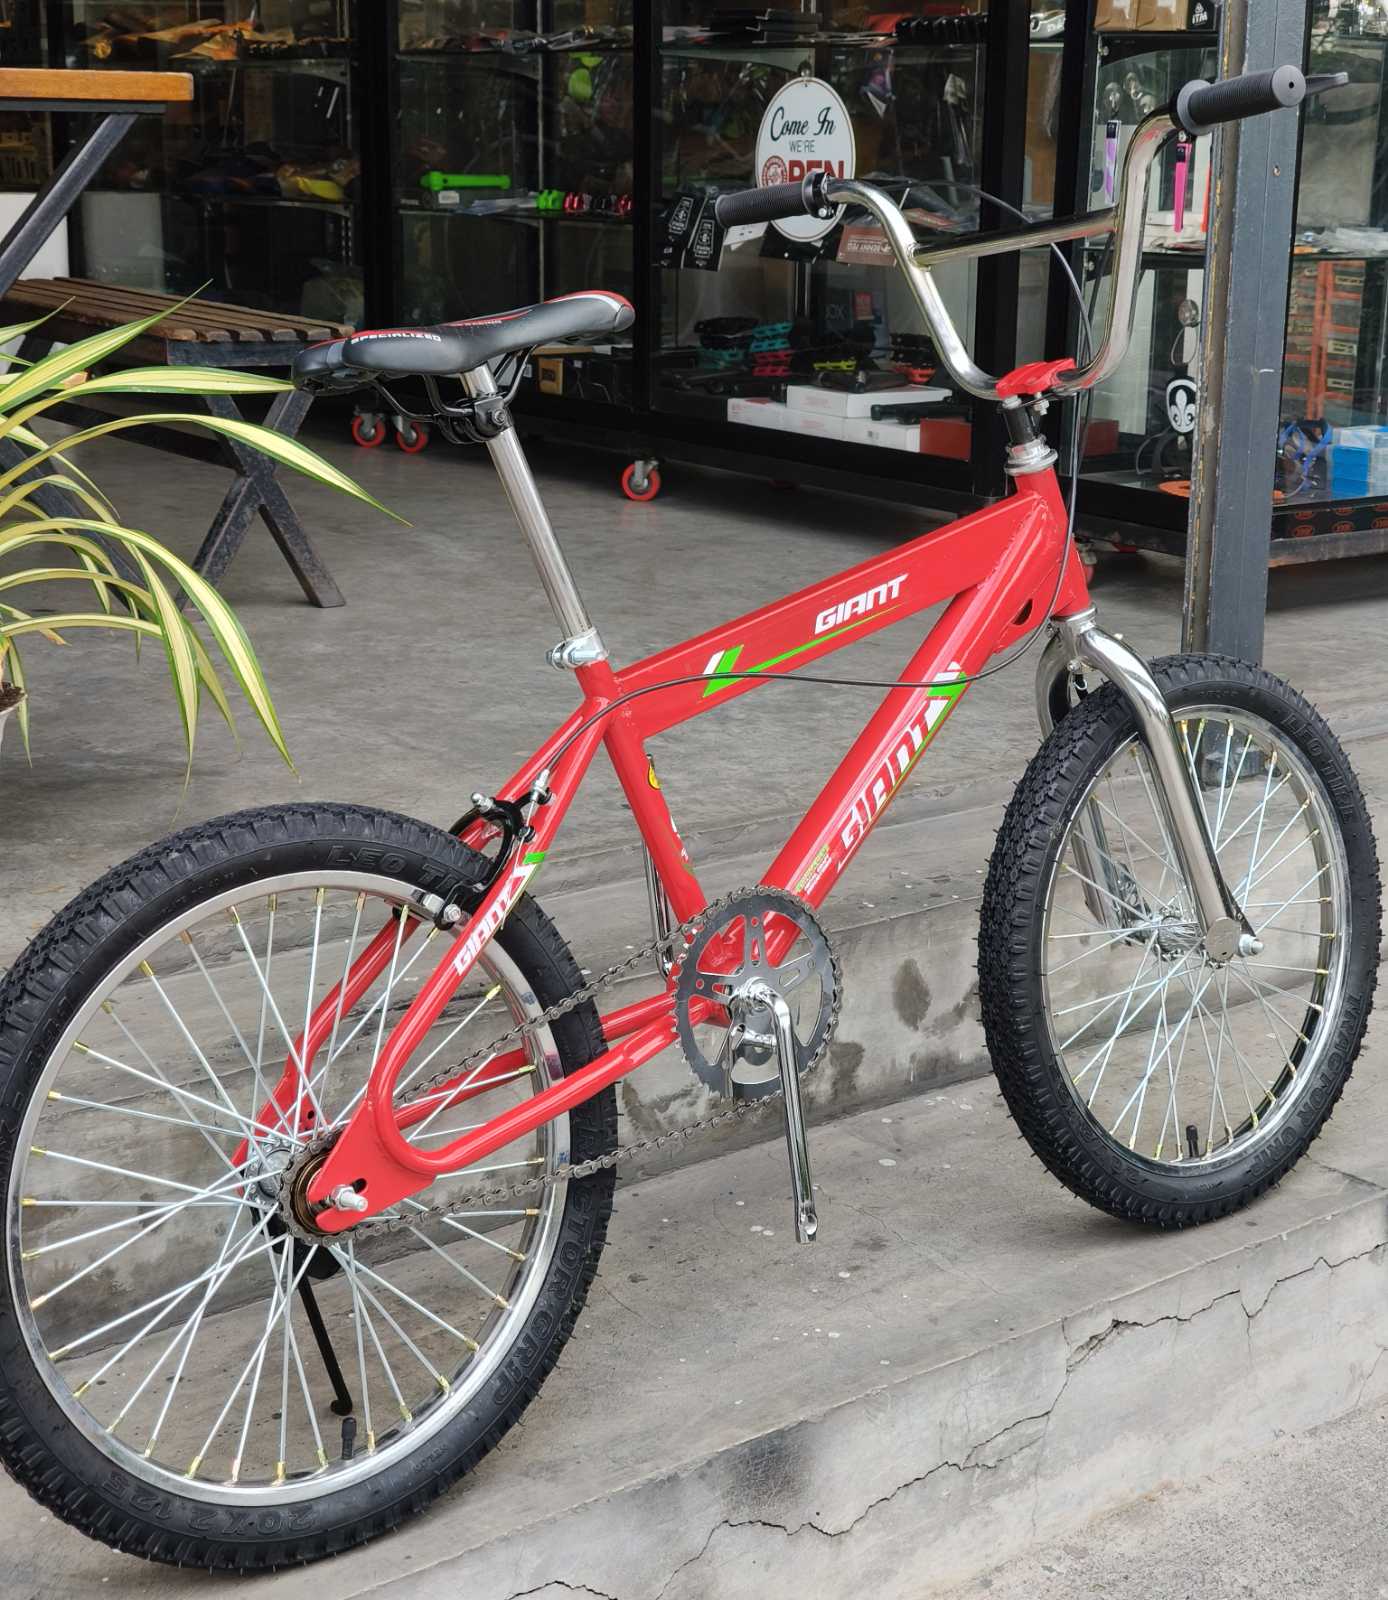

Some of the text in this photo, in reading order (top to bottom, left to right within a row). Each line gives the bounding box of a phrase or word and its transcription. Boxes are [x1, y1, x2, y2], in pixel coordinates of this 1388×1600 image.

[770, 105, 835, 142] Come In
[788, 139, 815, 153] WE'RE
[814, 573, 909, 634] GIANT
[837, 695, 941, 870] GIANT
[326, 845, 407, 874] LEO
[453, 875, 514, 977] GIANT
[493, 1310, 555, 1406] GRIP
